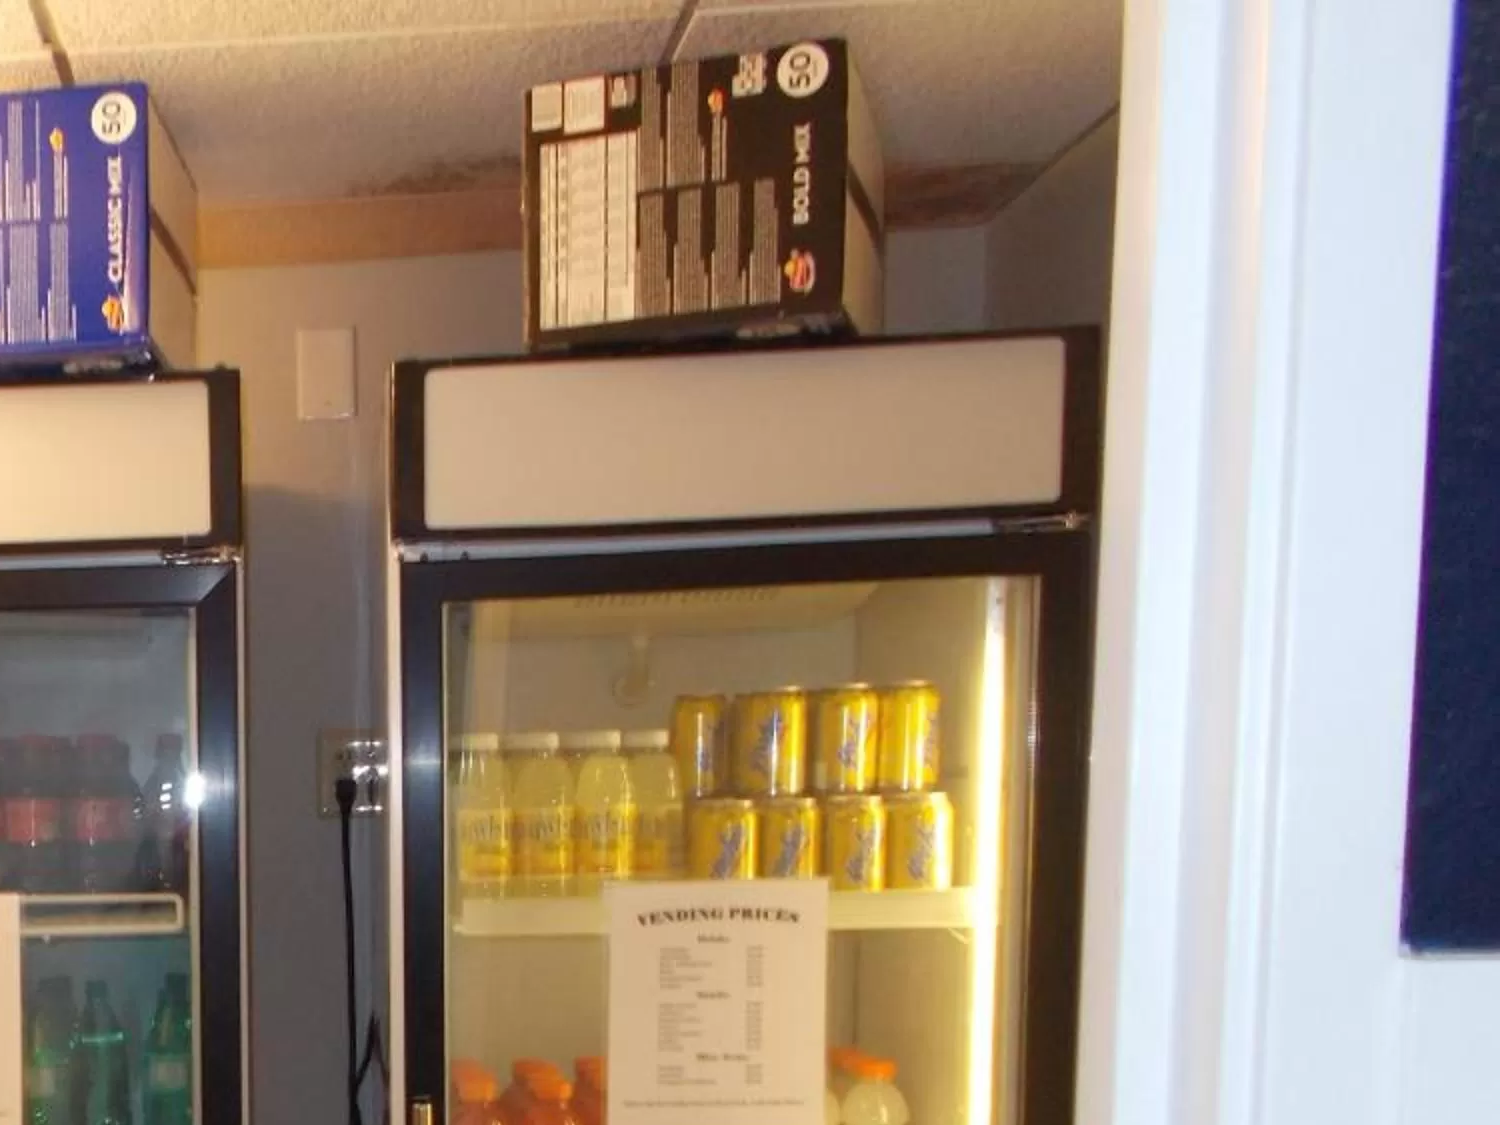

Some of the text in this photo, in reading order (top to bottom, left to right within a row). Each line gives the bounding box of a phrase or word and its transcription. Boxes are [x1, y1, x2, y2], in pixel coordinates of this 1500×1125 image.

[789, 52, 811, 90] 50
[102, 102, 122, 135] 50
[793, 121, 811, 225] BOLD MIX
[108, 155, 123, 282] CLASSIC MIX
[636, 907, 801, 927] VENDING PRICES
